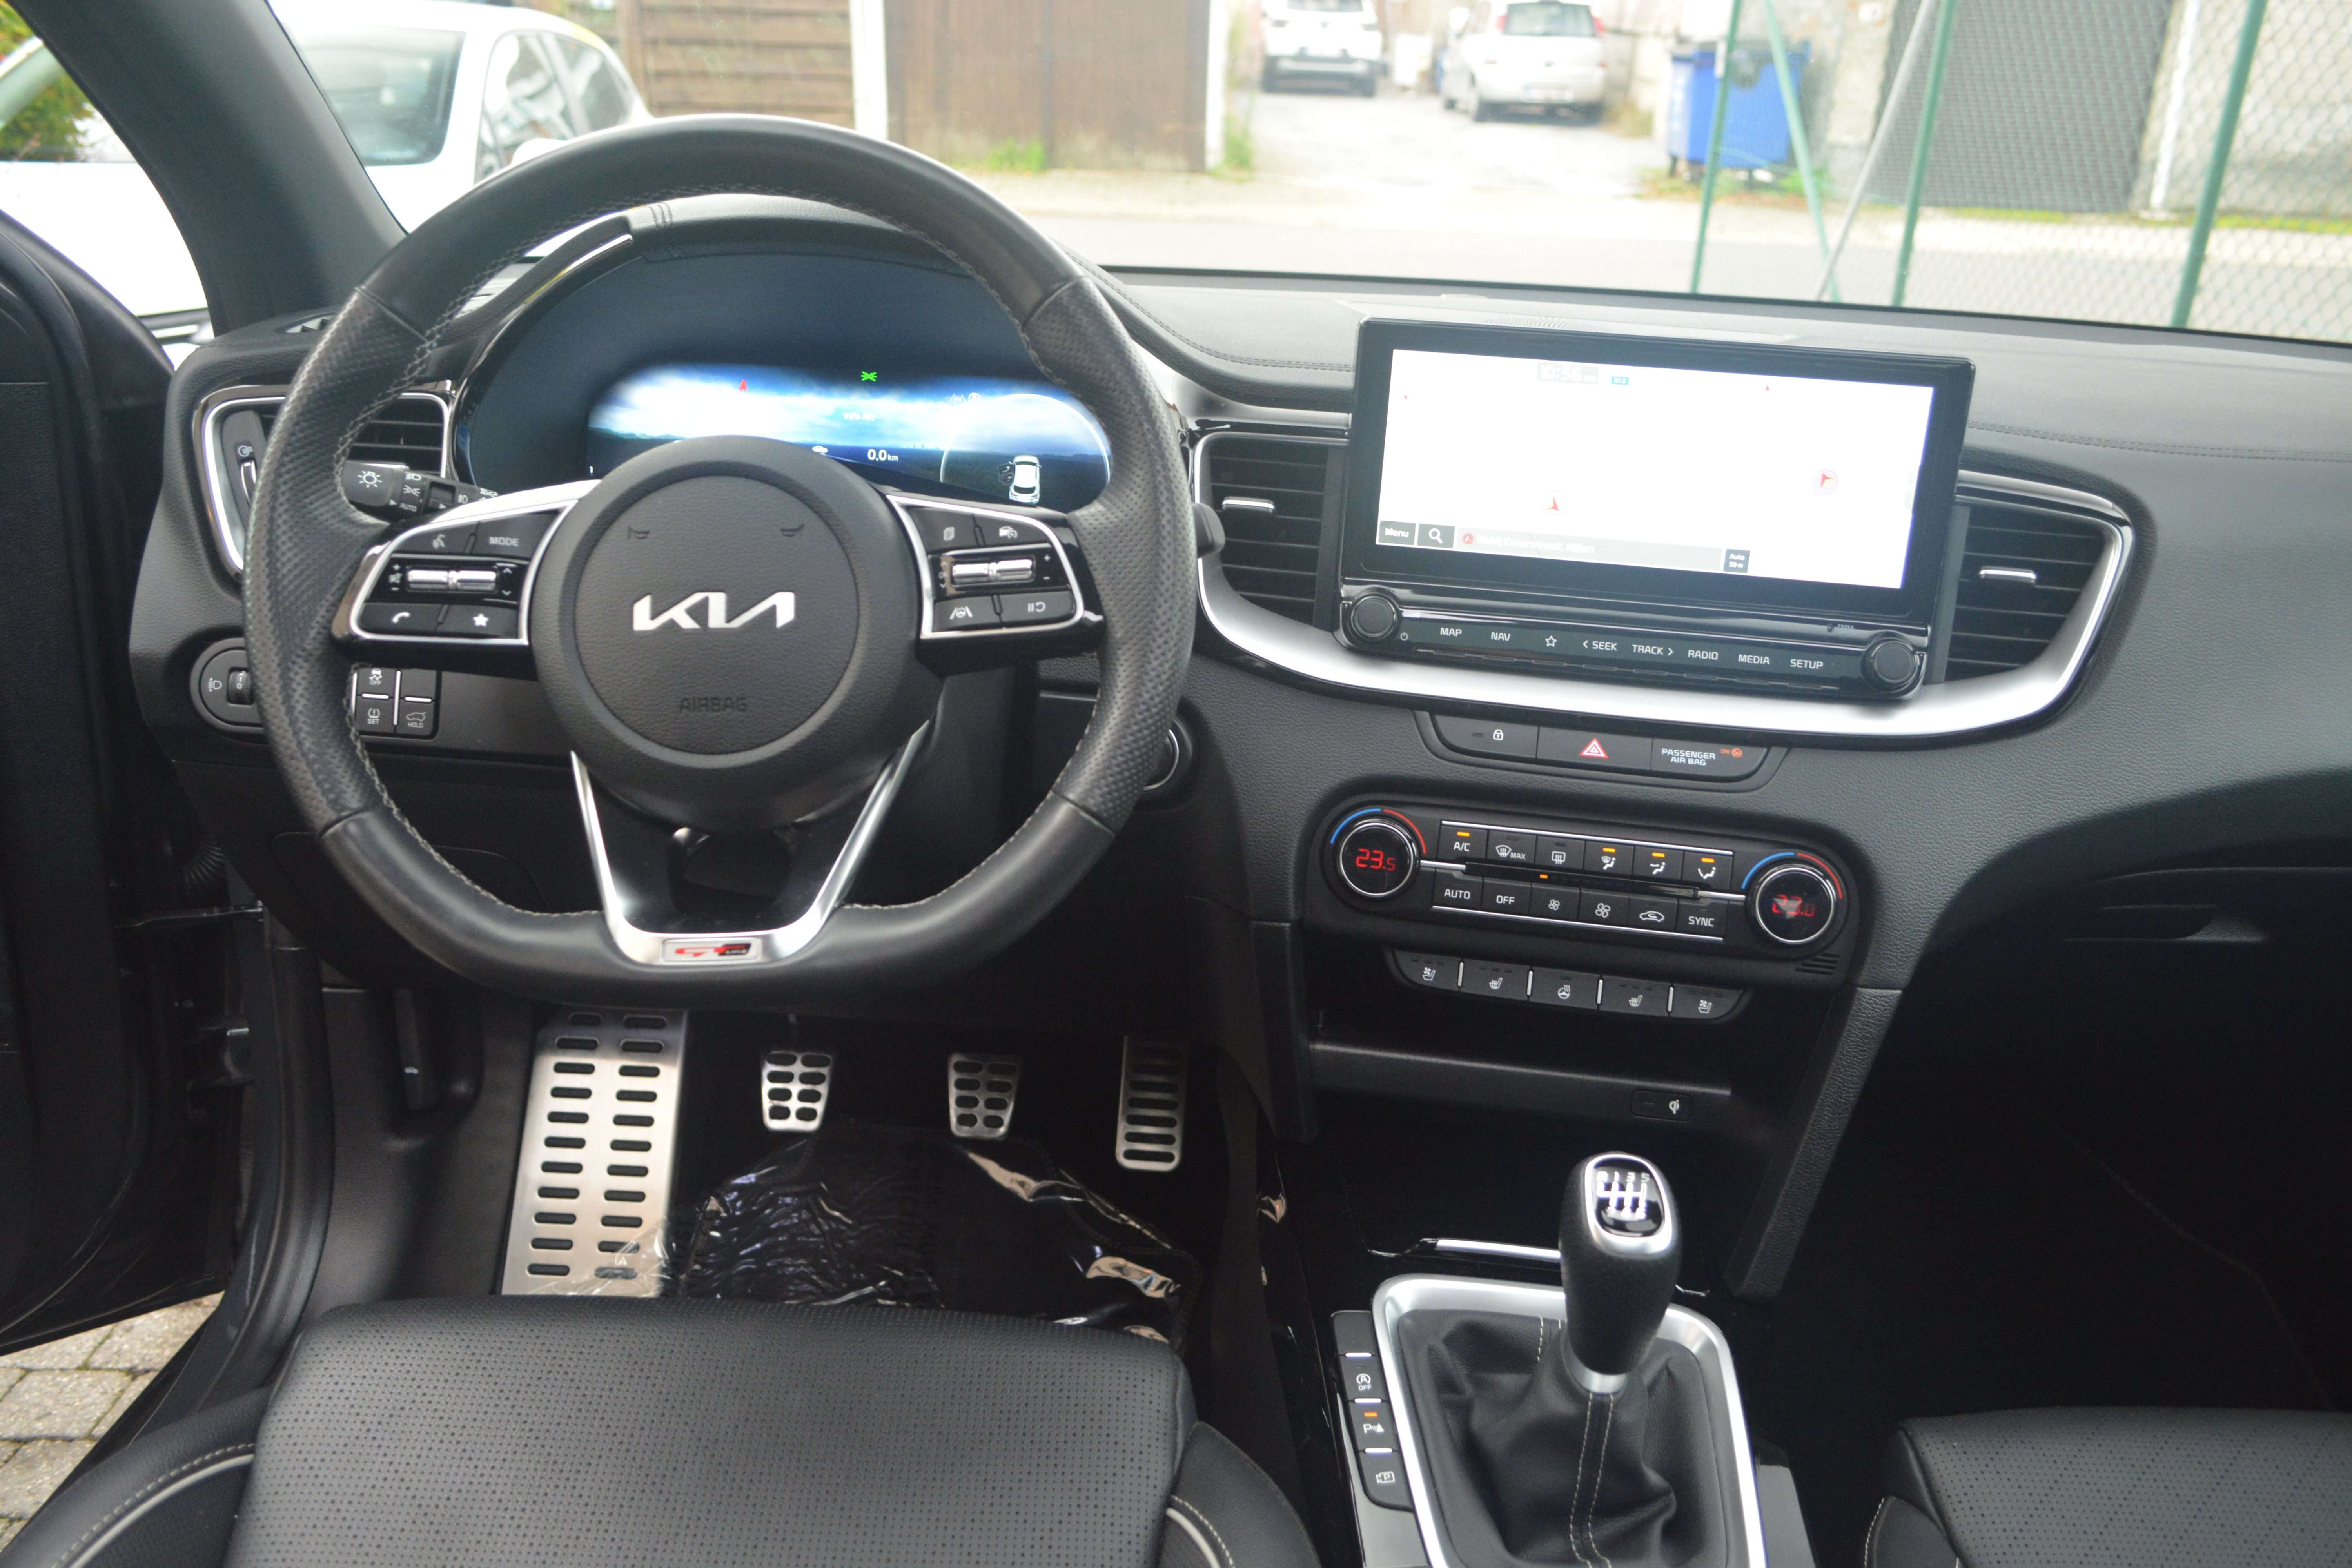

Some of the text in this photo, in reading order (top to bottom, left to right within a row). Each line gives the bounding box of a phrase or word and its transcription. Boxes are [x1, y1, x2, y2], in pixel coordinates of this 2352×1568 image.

[867, 448, 887, 461] 0.0
[399, 502, 417, 512] AUTO
[1385, 528, 1409, 537] Menu
[489, 536, 519, 546] MODE
[1440, 628, 1824, 670] MAP NAV SEEK TRACK RADIO MEDIA SETUP
[679, 697, 748, 713] AIRBAG
[1661, 748, 1715, 760] PASSENGER
[1453, 841, 1470, 852] A/C
[1356, 848, 1396, 871] 23.5
[1444, 889, 1470, 900] AUTO
[1496, 895, 1515, 905] OFF
[1688, 916, 1714, 927] SYNC
[1626, 1172, 1635, 1183] 3
[1641, 1173, 1650, 1183] 5
